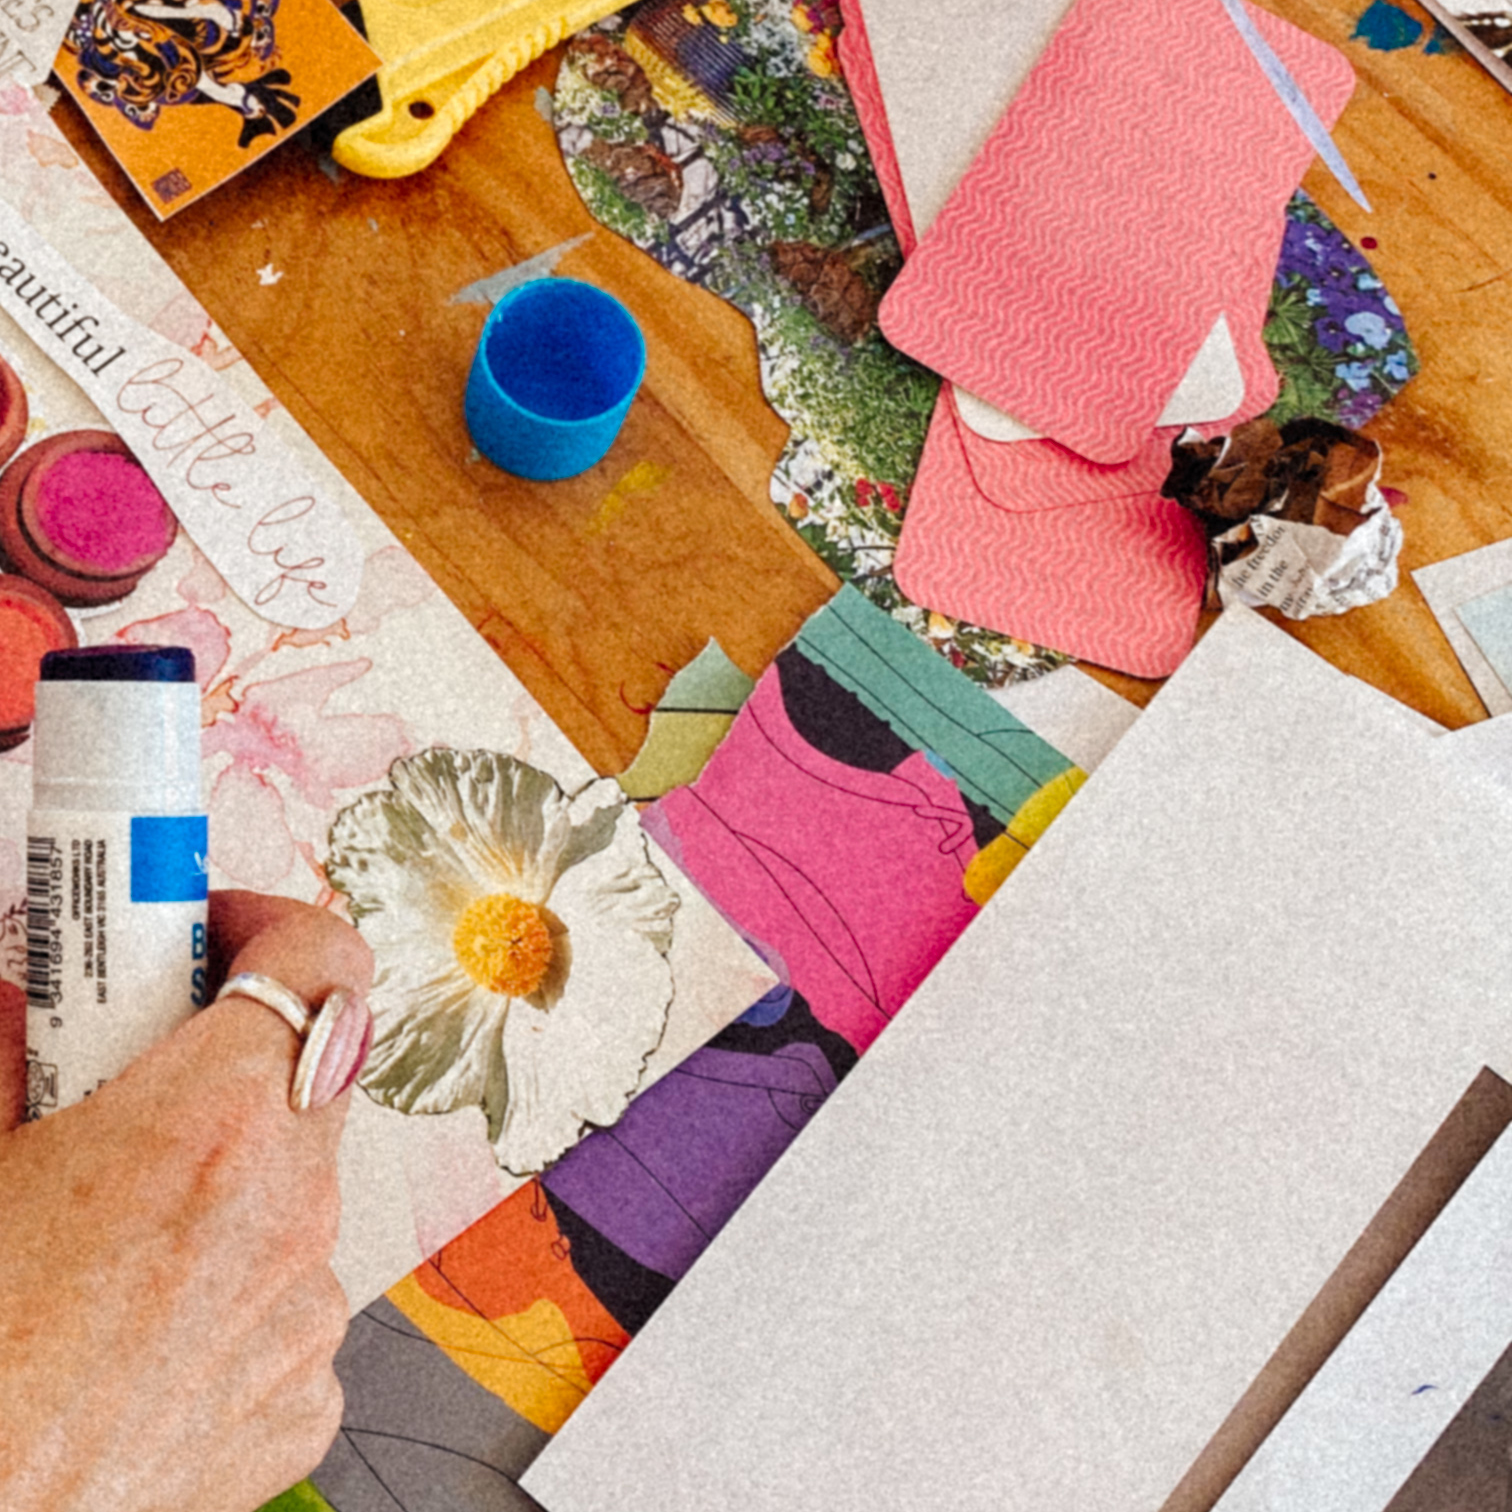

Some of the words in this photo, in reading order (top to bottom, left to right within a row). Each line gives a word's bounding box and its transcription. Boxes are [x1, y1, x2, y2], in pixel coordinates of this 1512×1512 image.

[116, 357, 256, 509] little
[248, 495, 338, 608] life
[1269, 558, 1289, 584] the
[84, 839, 94, 865] ROAD
[96, 839, 107, 889] AUSTRALIA
[50, 843, 64, 920] 431857
[84, 866, 94, 915] BOUNDARY
[84, 916, 94, 939] EAST
[50, 928, 64, 1004] 341694
[96, 930, 107, 979] BENTLEIGH
[96, 981, 107, 1004] EAST
[50, 1016, 64, 1029] 9
